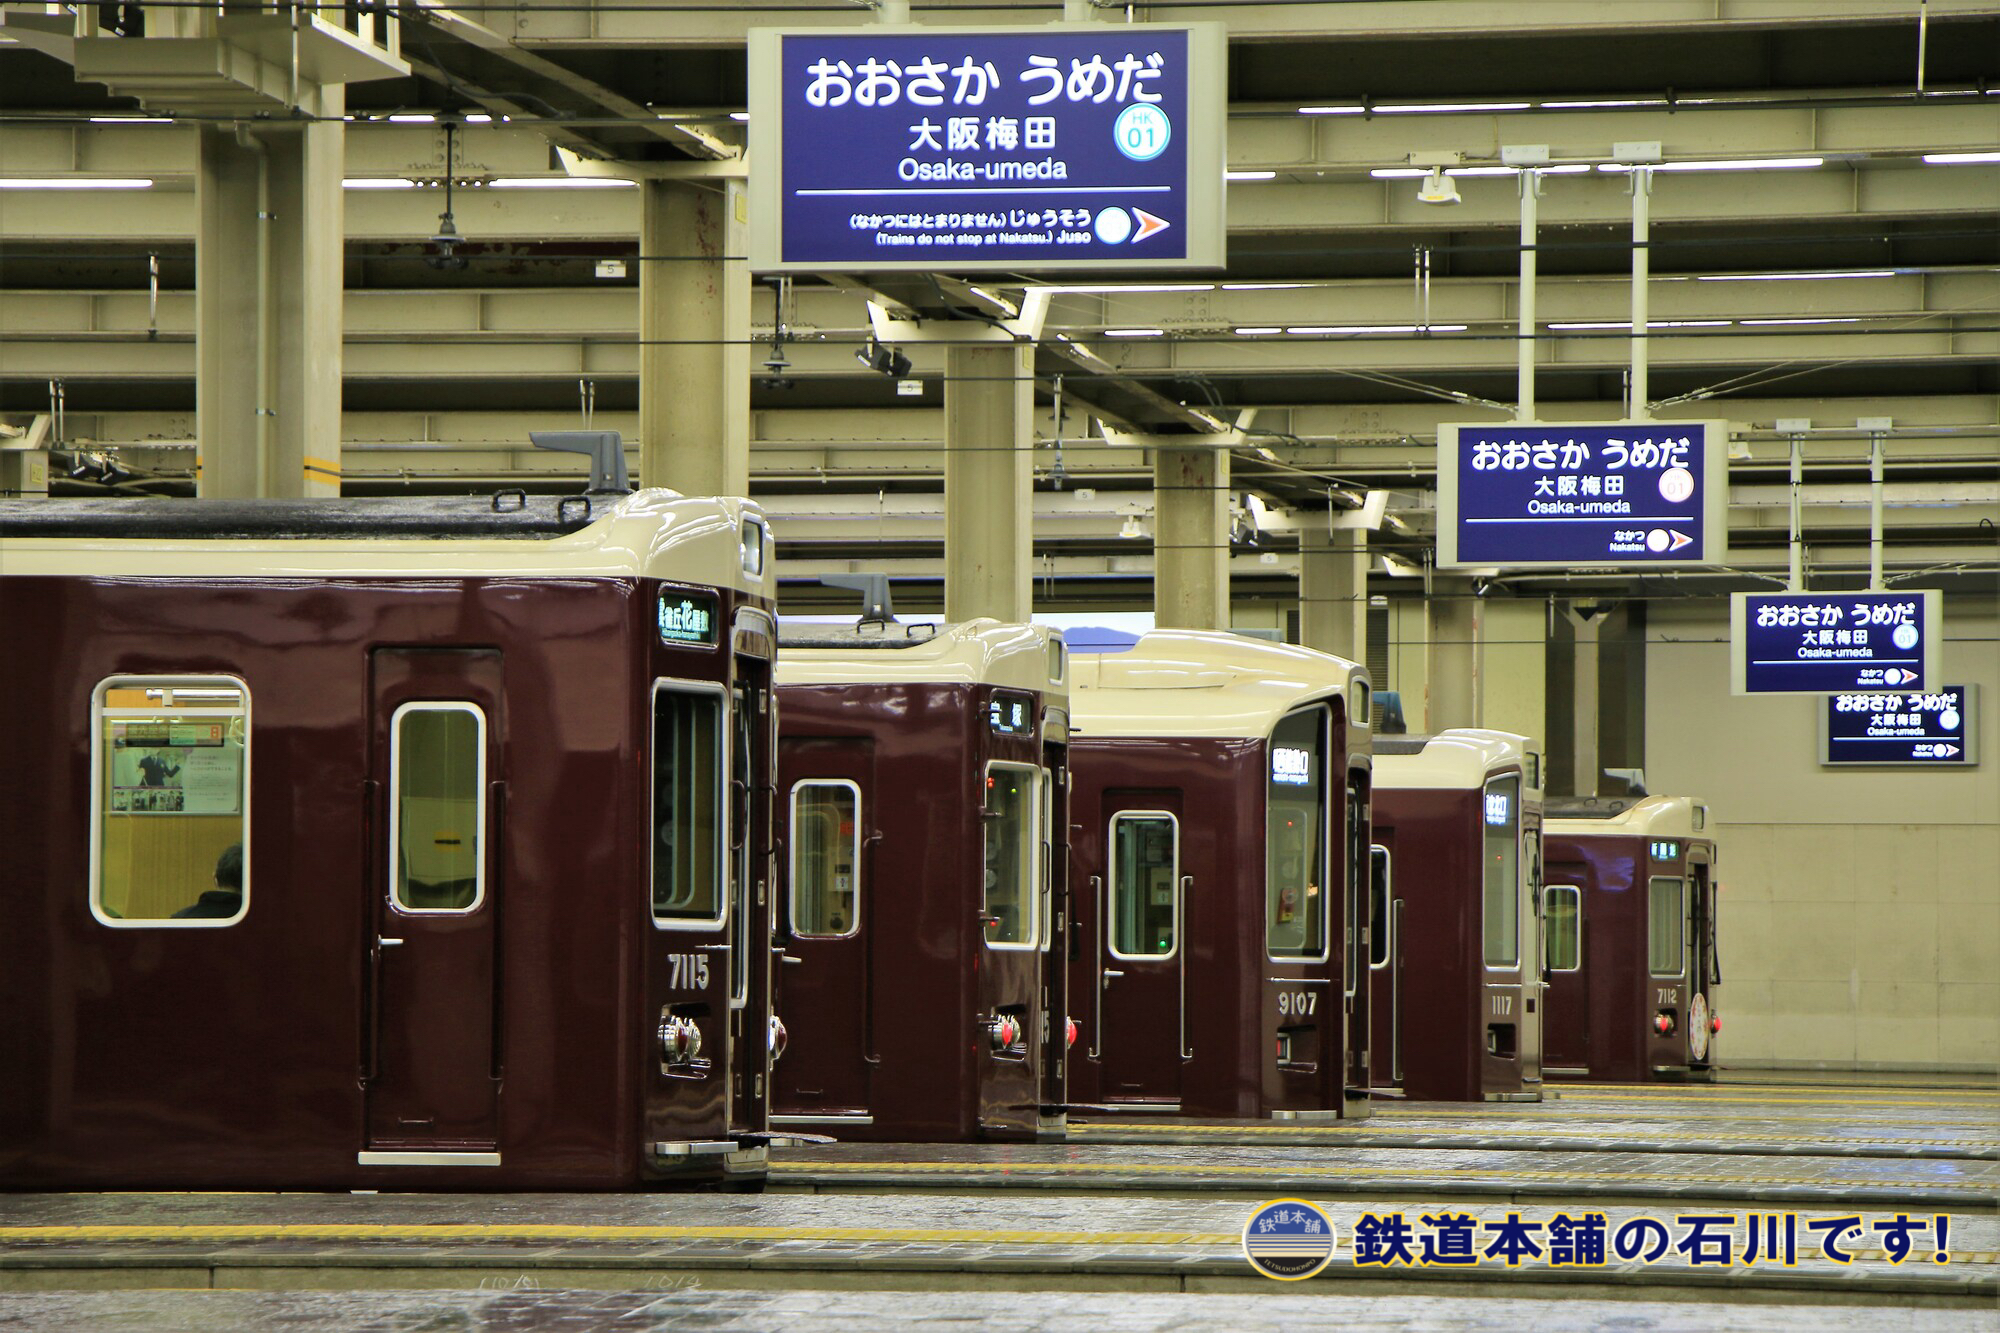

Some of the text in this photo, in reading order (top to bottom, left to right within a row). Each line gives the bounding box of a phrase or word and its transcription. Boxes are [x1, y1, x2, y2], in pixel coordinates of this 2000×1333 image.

[805, 51, 1166, 107] おおさか うめだ
[1132, 111, 1153, 125] HK
[908, 116, 1057, 151] 大阪梅田
[1127, 127, 1154, 149] 01
[897, 156, 1068, 182] Osaka-umeda
[1009, 208, 1092, 228] じゅうそう
[876, 231, 915, 246] (Trains
[917, 232, 933, 246] do
[935, 232, 955, 246] not
[956, 232, 983, 248] stop
[984, 231, 997, 245] at
[1056, 228, 1092, 245] Juso
[607, 264, 615, 274] 5
[1471, 437, 1691, 471] おおさか うめだ
[1534, 475, 1624, 497] 大阪梅田
[1527, 498, 1631, 515] Osaka-umeda
[1613, 529, 1646, 542] なかつ
[1609, 542, 1646, 552] Nakatsu
[1756, 602, 1916, 627] おおさか うめだ
[1801, 629, 1868, 646] 大阪梅田
[1797, 646, 1873, 659] Osaka-umeda
[1835, 692, 1958, 712] おおさか うめだ
[1870, 713, 1922, 727] 大阪梅田
[1866, 725, 1926, 737] Osaka-umeda
[667, 953, 710, 990] 7115
[1278, 991, 1317, 1015] 9107
[1492, 995, 1512, 1015] 1117
[1657, 988, 1677, 1004] 7112
